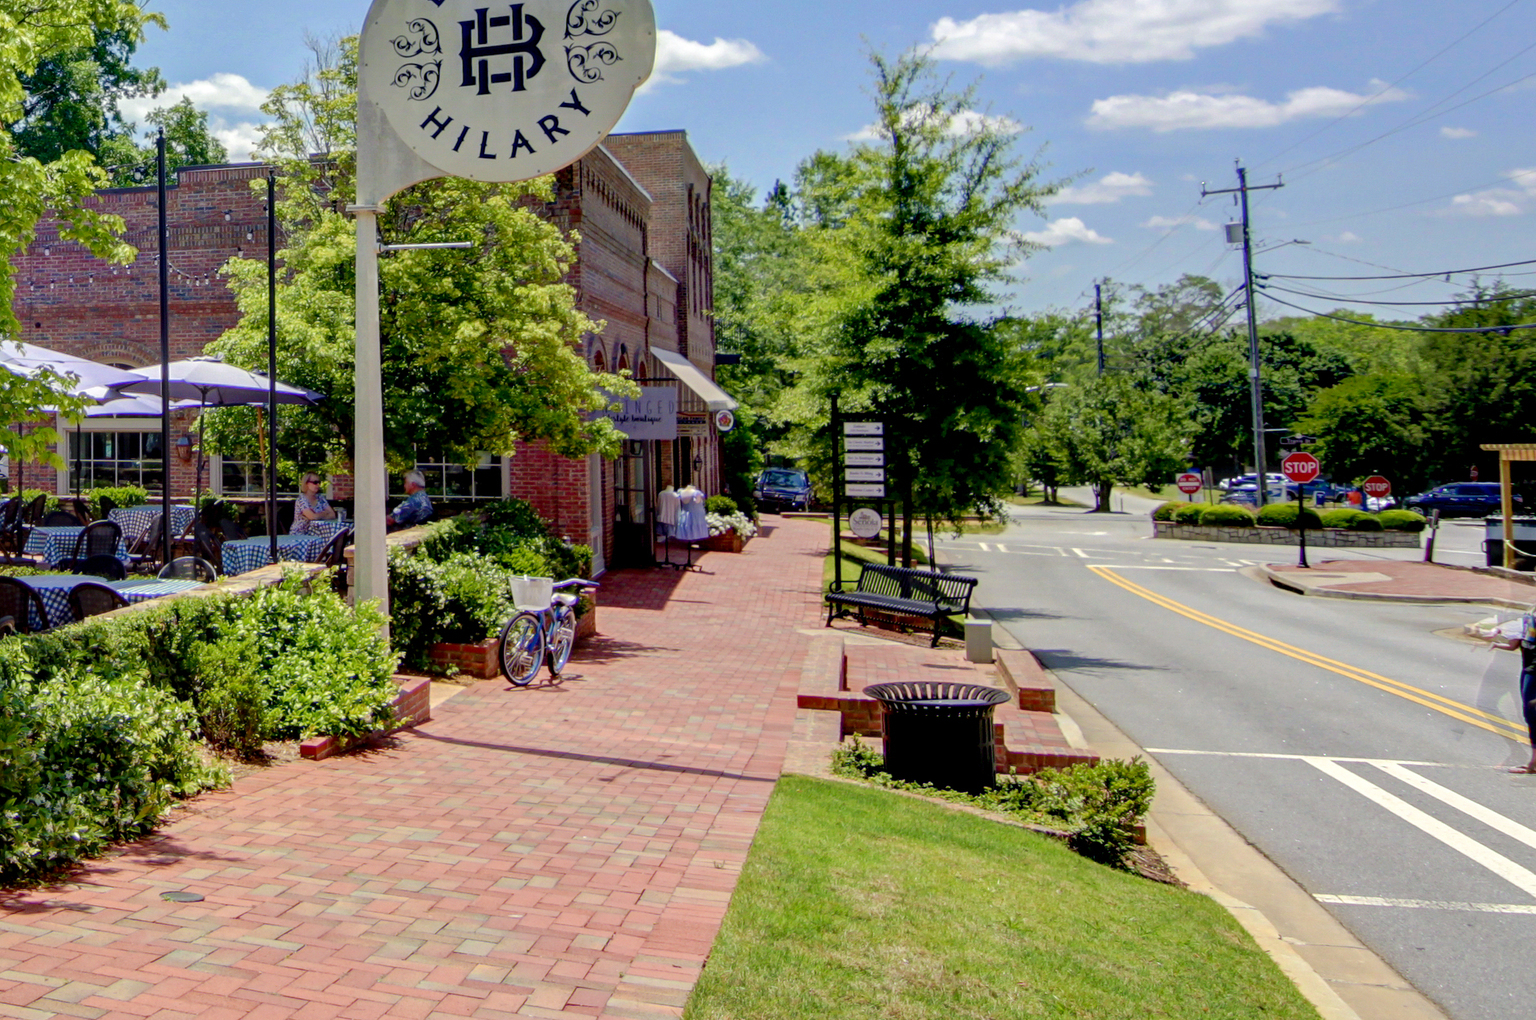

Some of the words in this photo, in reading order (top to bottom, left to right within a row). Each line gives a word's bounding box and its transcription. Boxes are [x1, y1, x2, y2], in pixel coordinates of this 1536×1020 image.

[420, 87, 592, 160] HILARY
[1284, 462, 1317, 474] STOP
[1365, 482, 1389, 492] STOP
